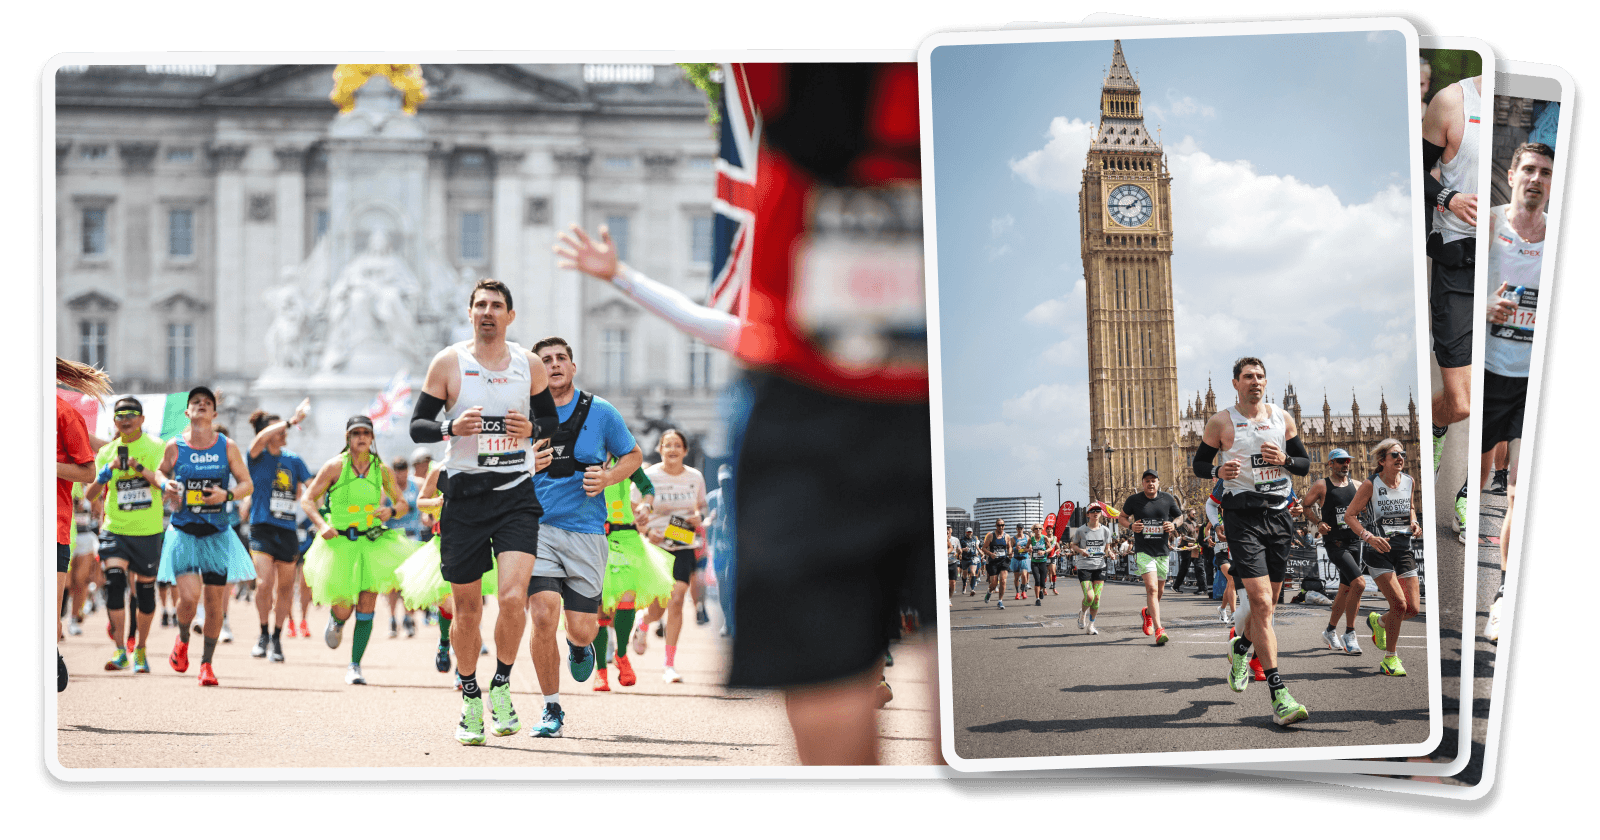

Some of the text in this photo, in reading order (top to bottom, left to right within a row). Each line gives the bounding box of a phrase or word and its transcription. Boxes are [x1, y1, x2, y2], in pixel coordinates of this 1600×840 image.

[1517, 249, 1541, 257] APEX
[487, 377, 508, 385] APEX
[481, 420, 501, 431] tcs
[487, 437, 518, 451] 11174
[190, 452, 219, 464] Gabe
[187, 479, 202, 490] tcs
[1272, 675, 1281, 684] C
[464, 683, 475, 691] C
